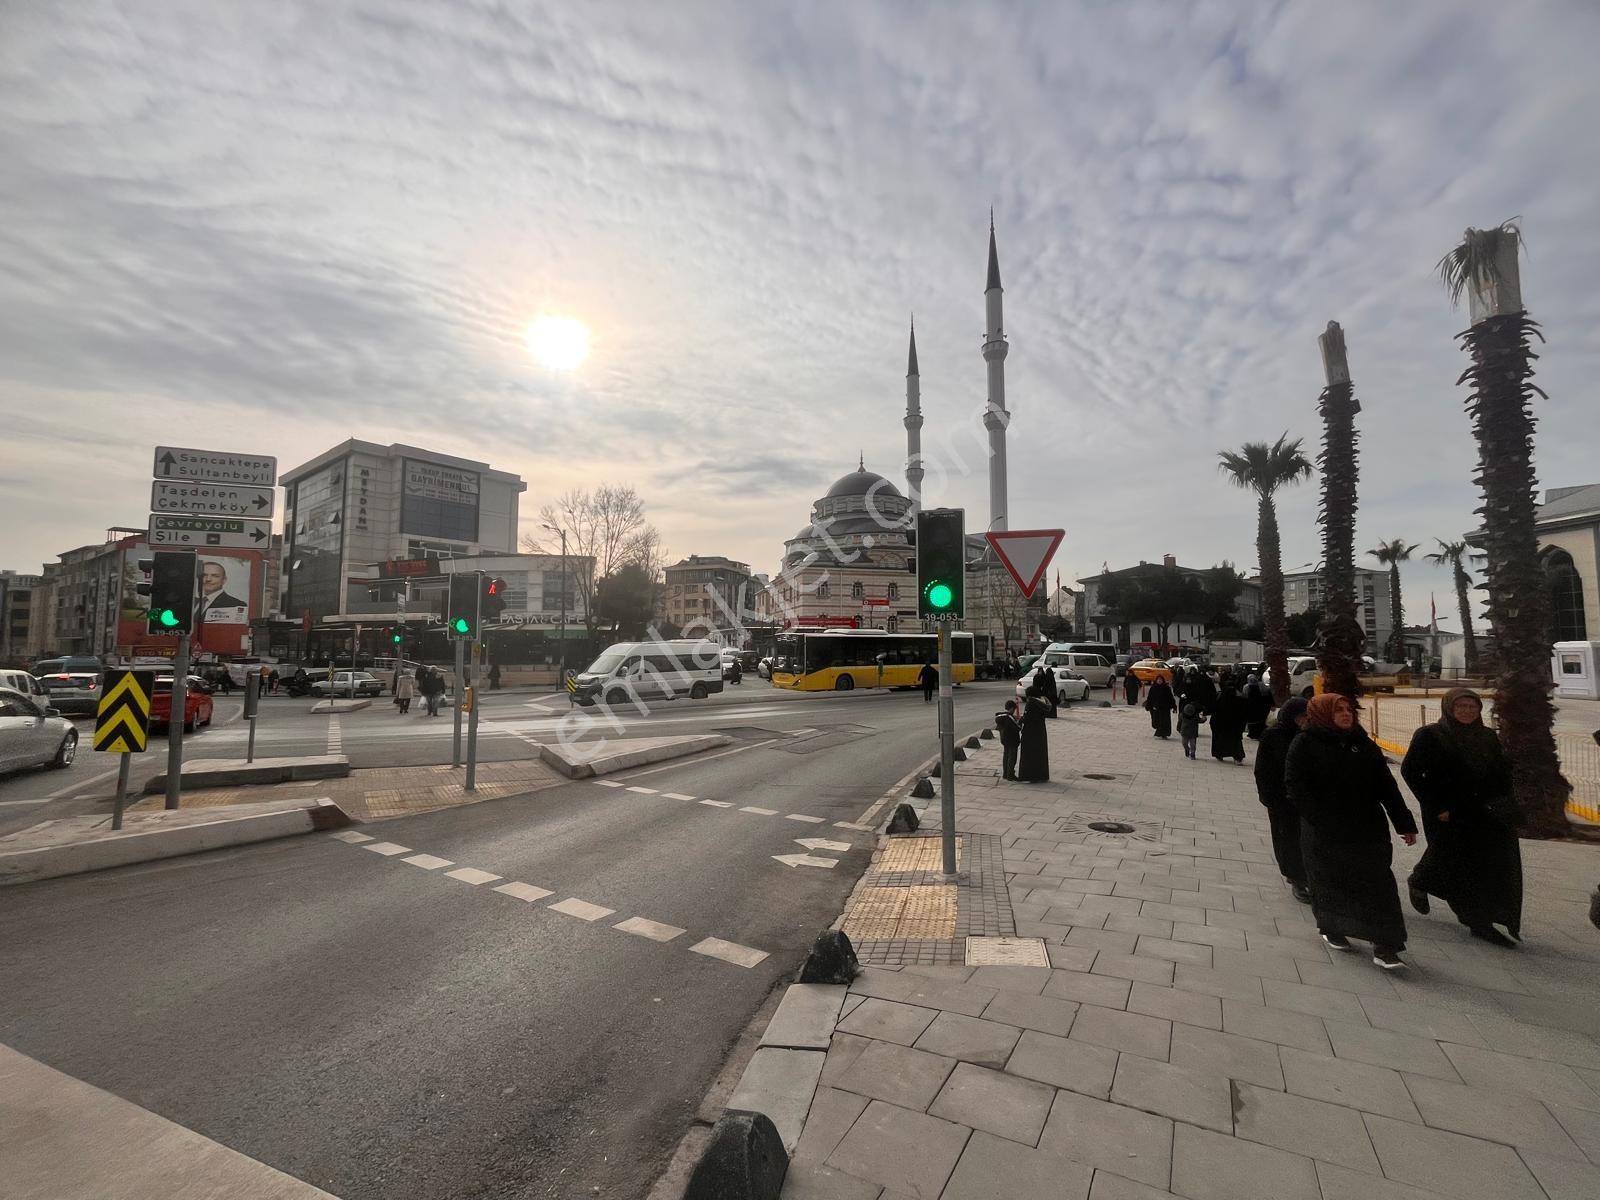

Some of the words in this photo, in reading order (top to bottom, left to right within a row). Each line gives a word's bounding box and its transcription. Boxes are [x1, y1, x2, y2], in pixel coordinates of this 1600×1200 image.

[180, 453, 270, 469] Sancaktepe
[179, 466, 269, 482] Sultanbeyli
[159, 485, 238, 499] Taşdelen
[158, 498, 248, 513] Çekmeköy
[156, 517, 238, 531] Çevreyolu
[155, 531, 191, 542] Şile
[924, 613, 958, 622] 39-053
